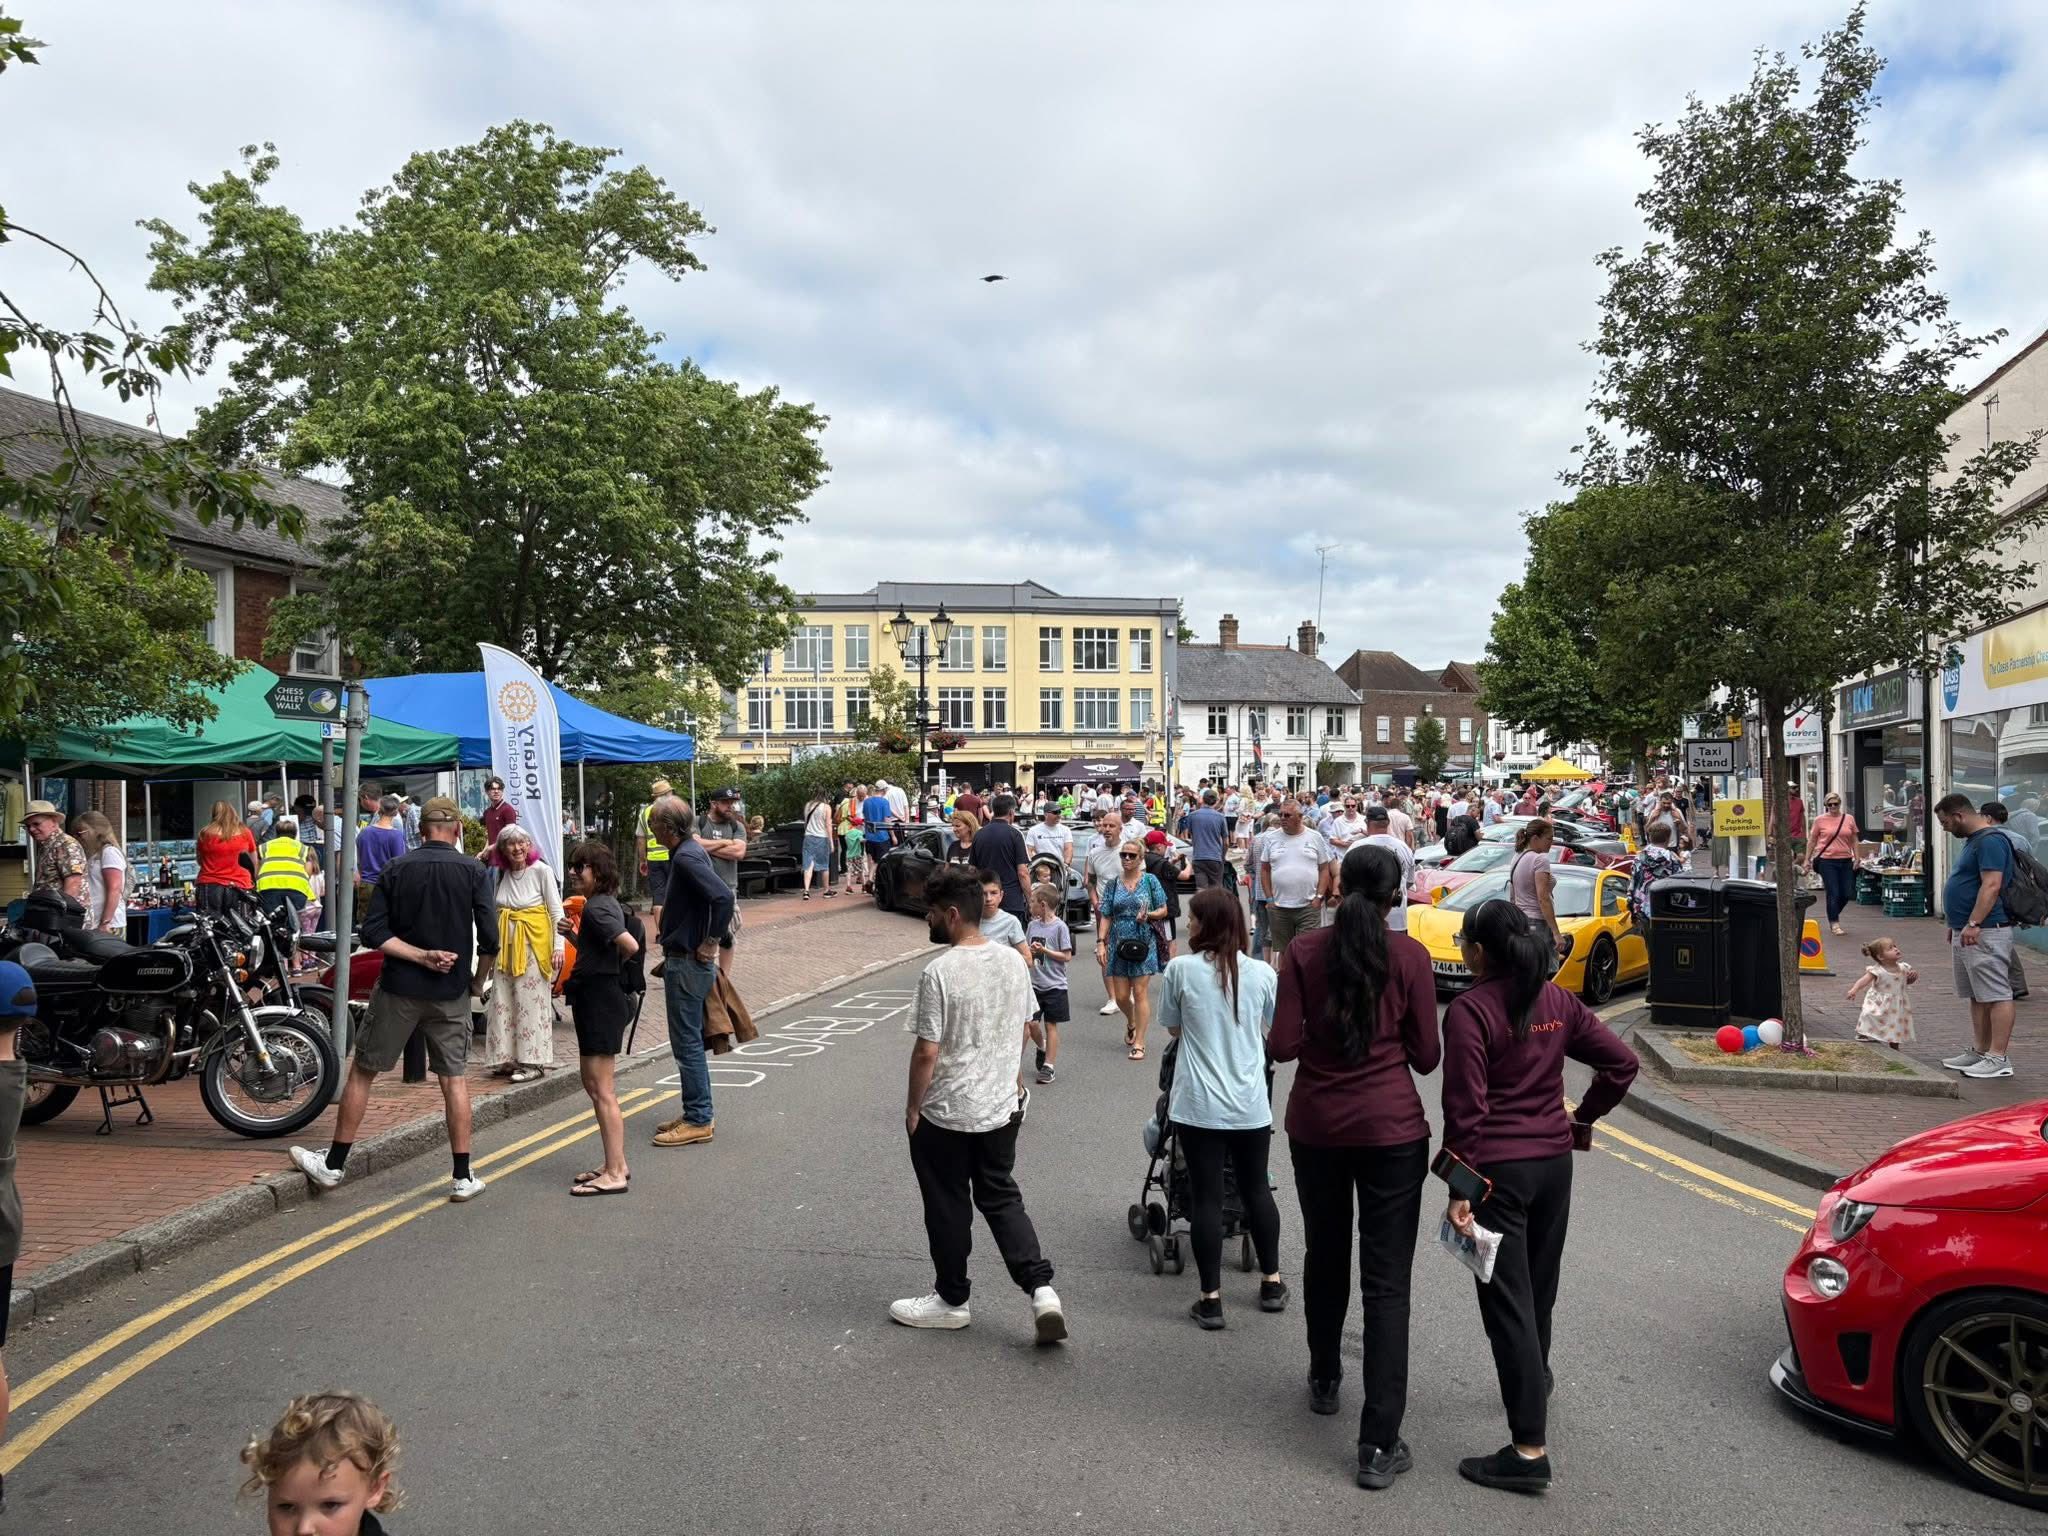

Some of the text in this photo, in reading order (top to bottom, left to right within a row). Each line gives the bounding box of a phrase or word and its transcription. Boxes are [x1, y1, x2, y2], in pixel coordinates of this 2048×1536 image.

[277, 687, 304, 695] CHESS
[274, 694, 305, 703] VALLEY
[276, 703, 301, 711] WALK
[1699, 747, 1721, 756] Taxi
[1693, 758, 1728, 768] Stand
